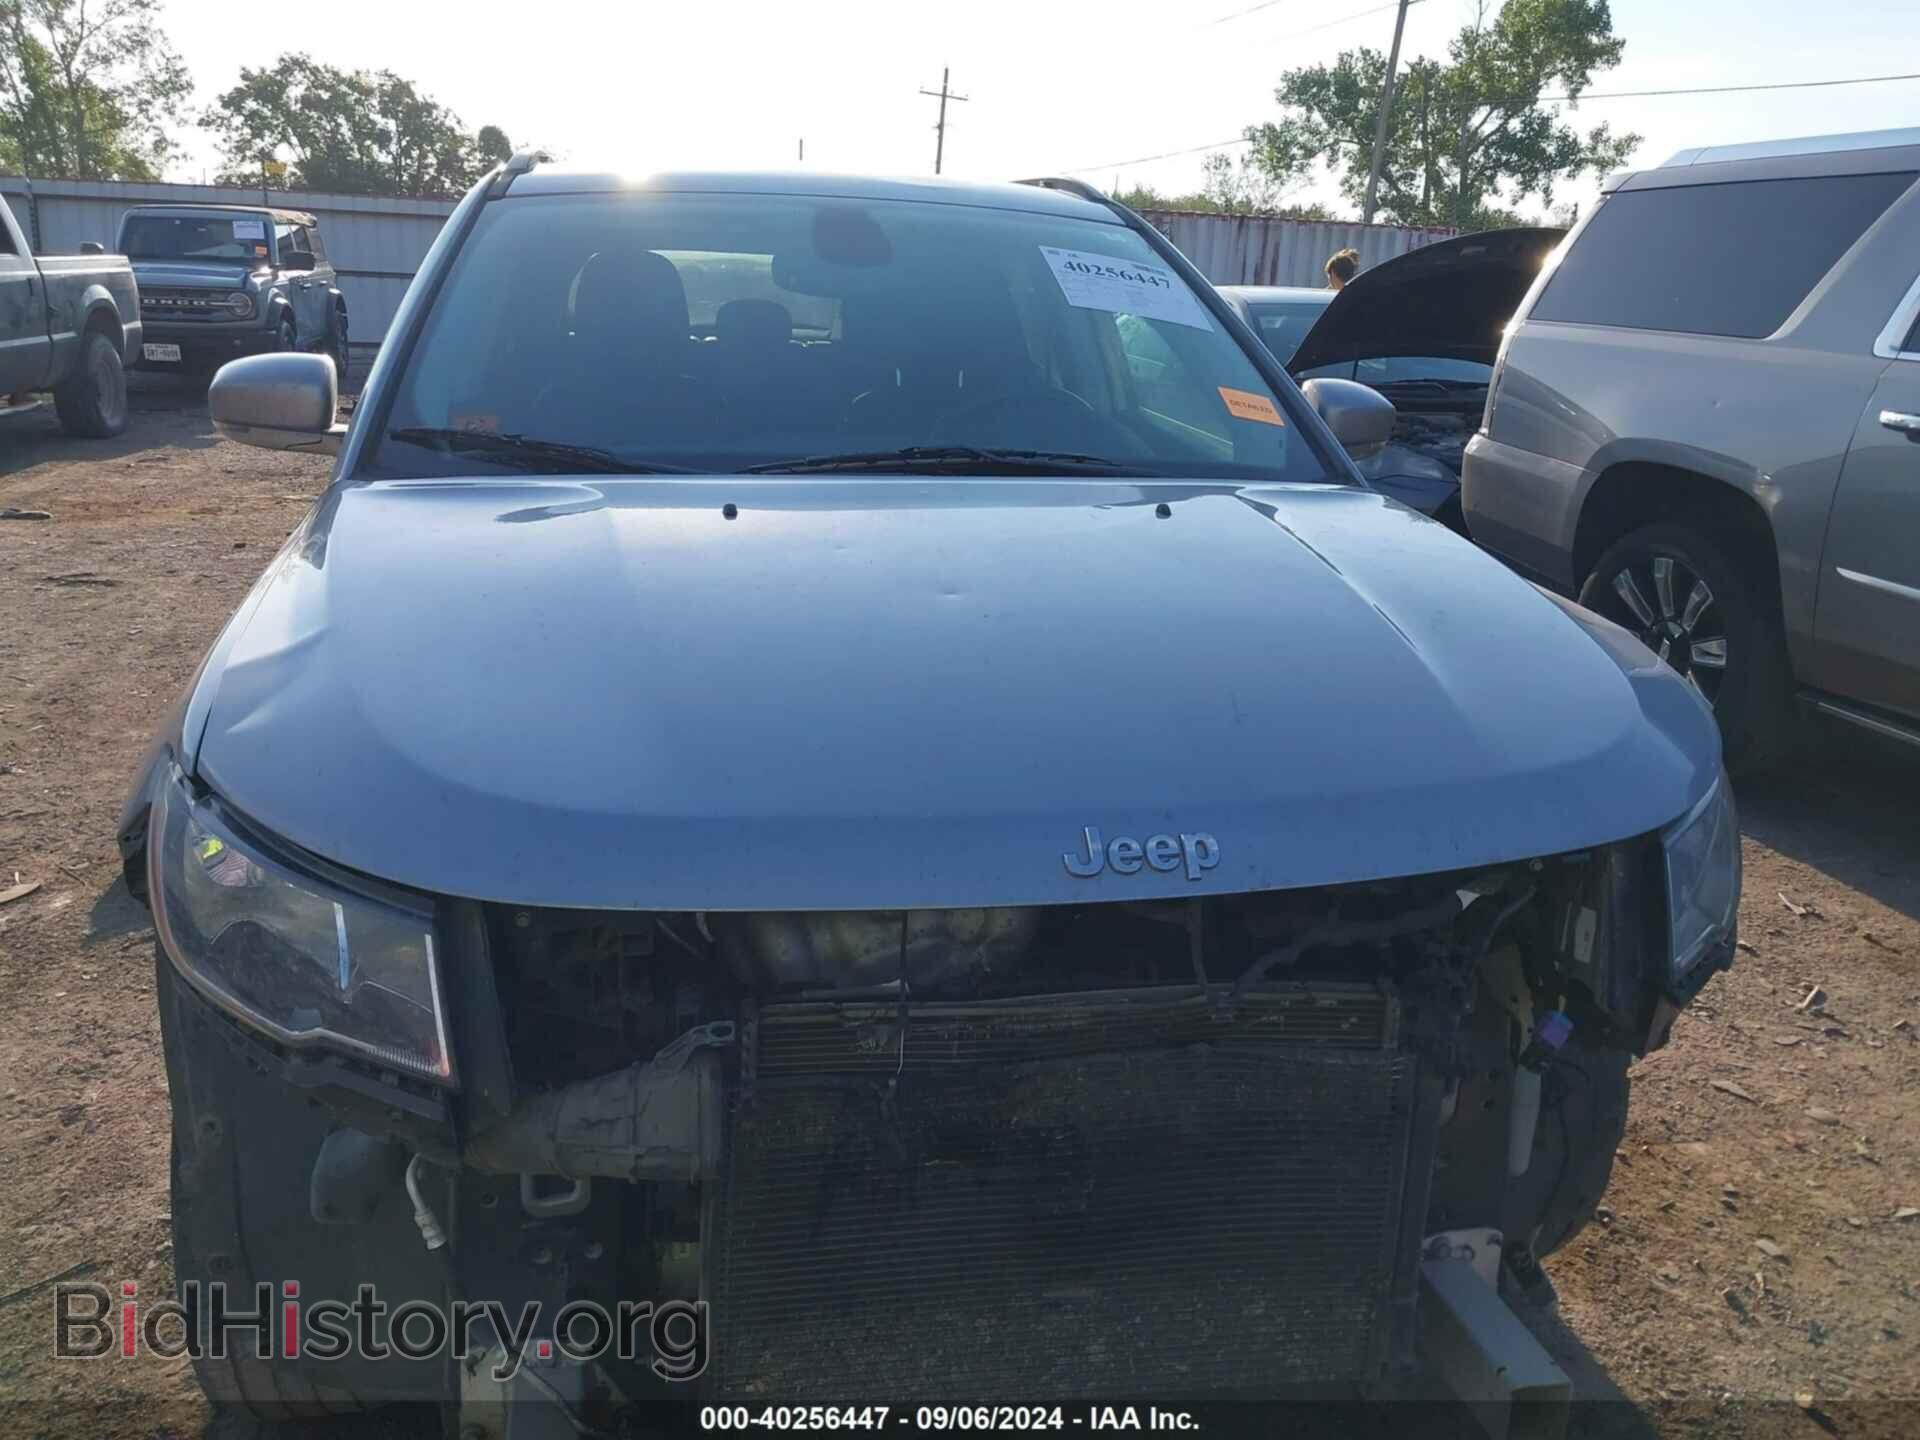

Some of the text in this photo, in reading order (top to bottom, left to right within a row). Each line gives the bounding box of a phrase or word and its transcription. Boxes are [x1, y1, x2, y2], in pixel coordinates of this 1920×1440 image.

[1063, 260, 1171, 289] 40256447
[143, 297, 207, 306] ONCO
[1063, 824, 1221, 881] Jeep
